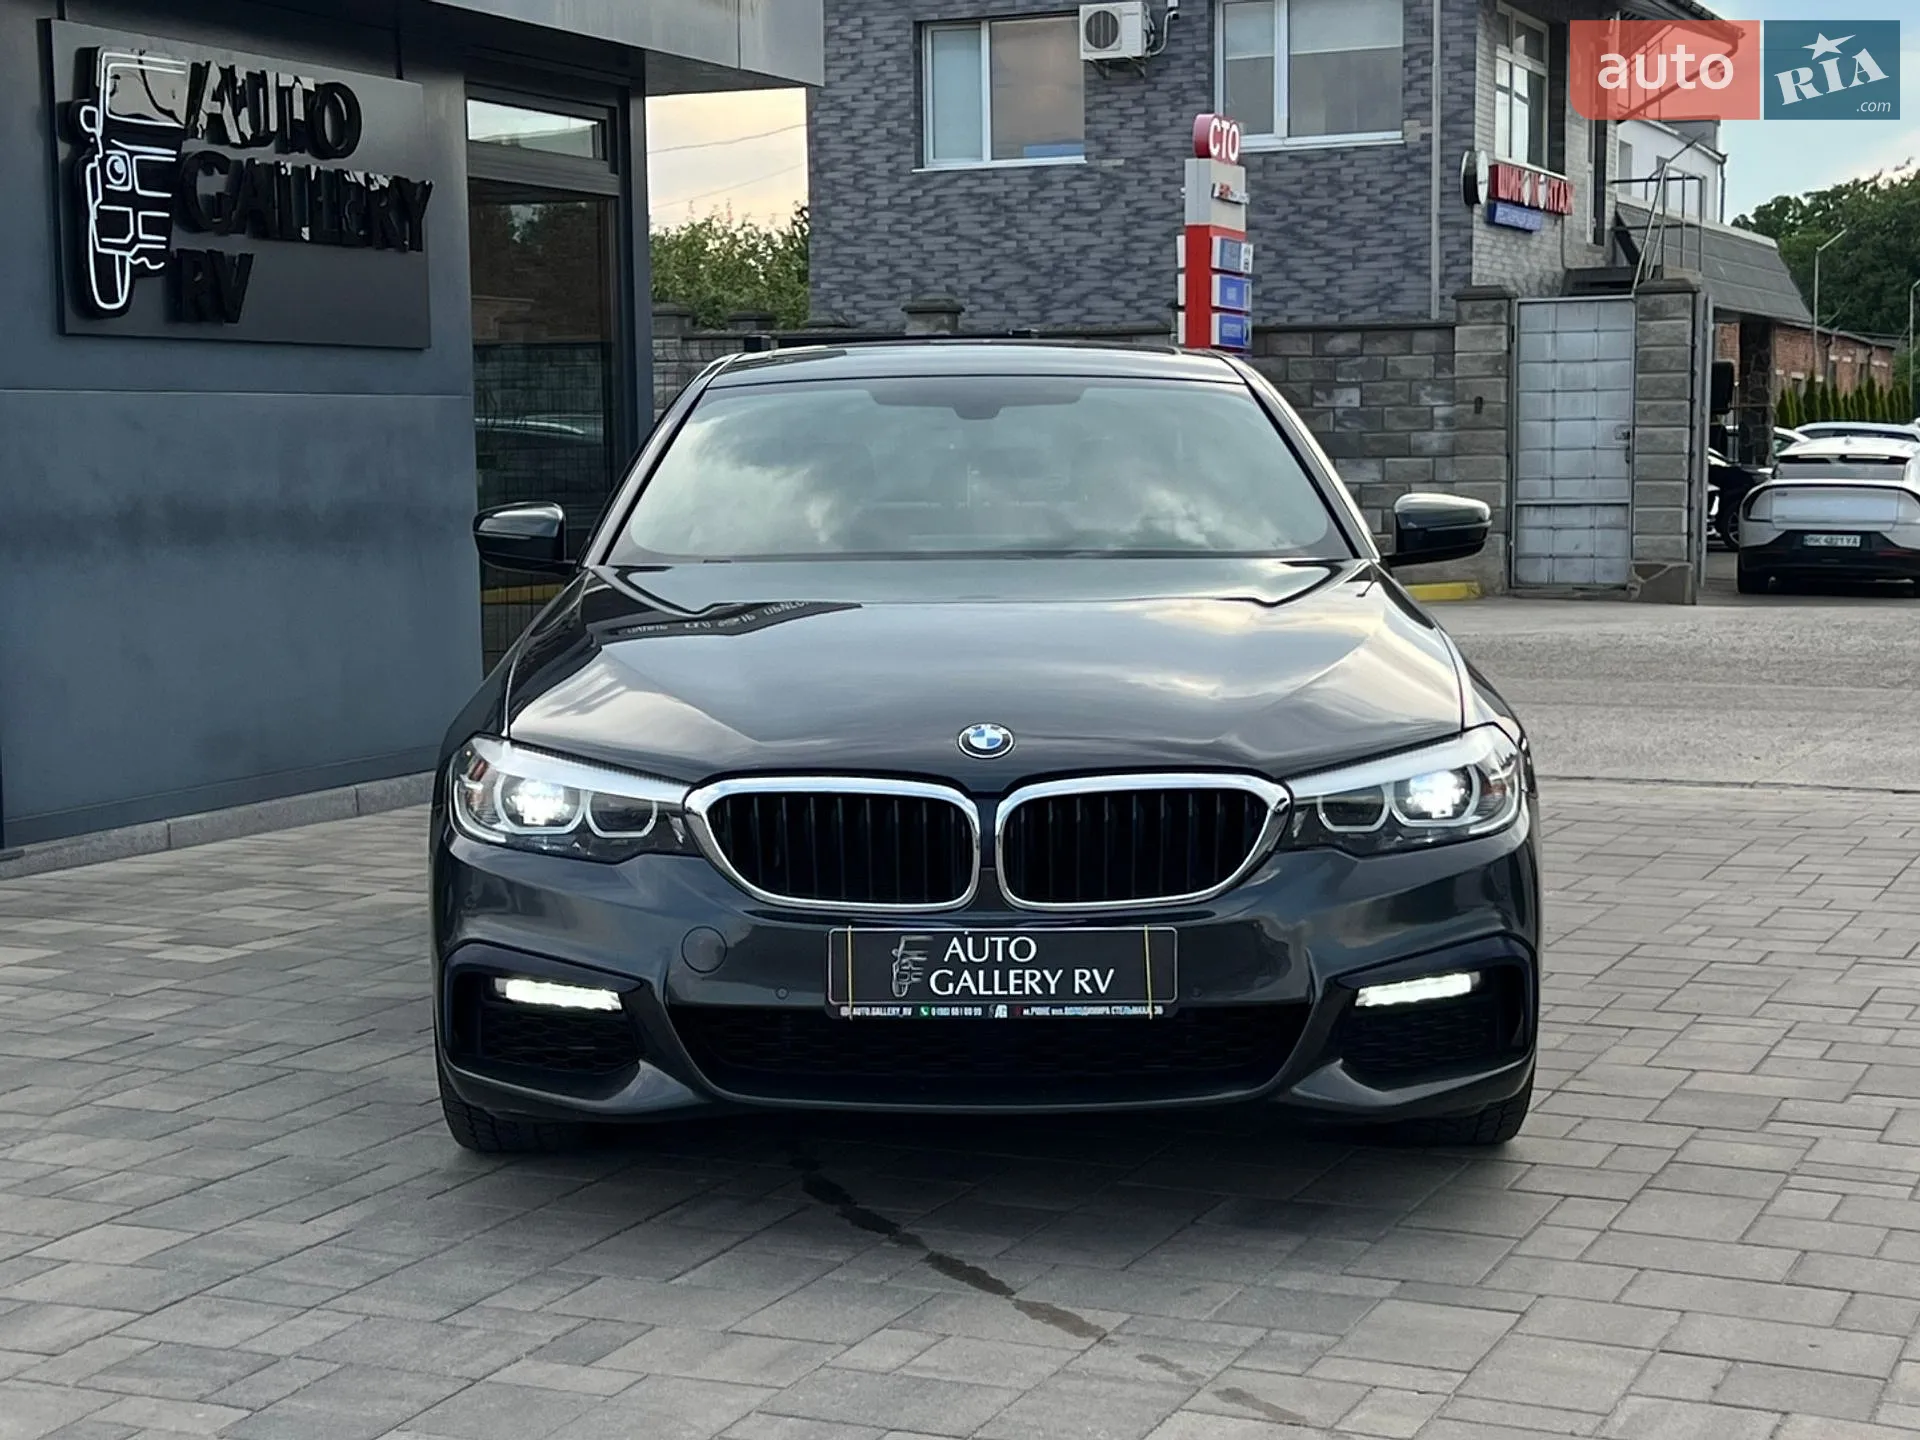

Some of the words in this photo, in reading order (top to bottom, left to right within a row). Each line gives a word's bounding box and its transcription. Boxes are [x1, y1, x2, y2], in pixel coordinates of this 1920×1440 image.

[185, 61, 362, 160] AUTO
[179, 150, 434, 252] GALLERY
[170, 248, 255, 324] RV
[930, 969, 1063, 995] GALLERY
[1074, 968, 1114, 995] RV
[944, 937, 1037, 962] AUTO
